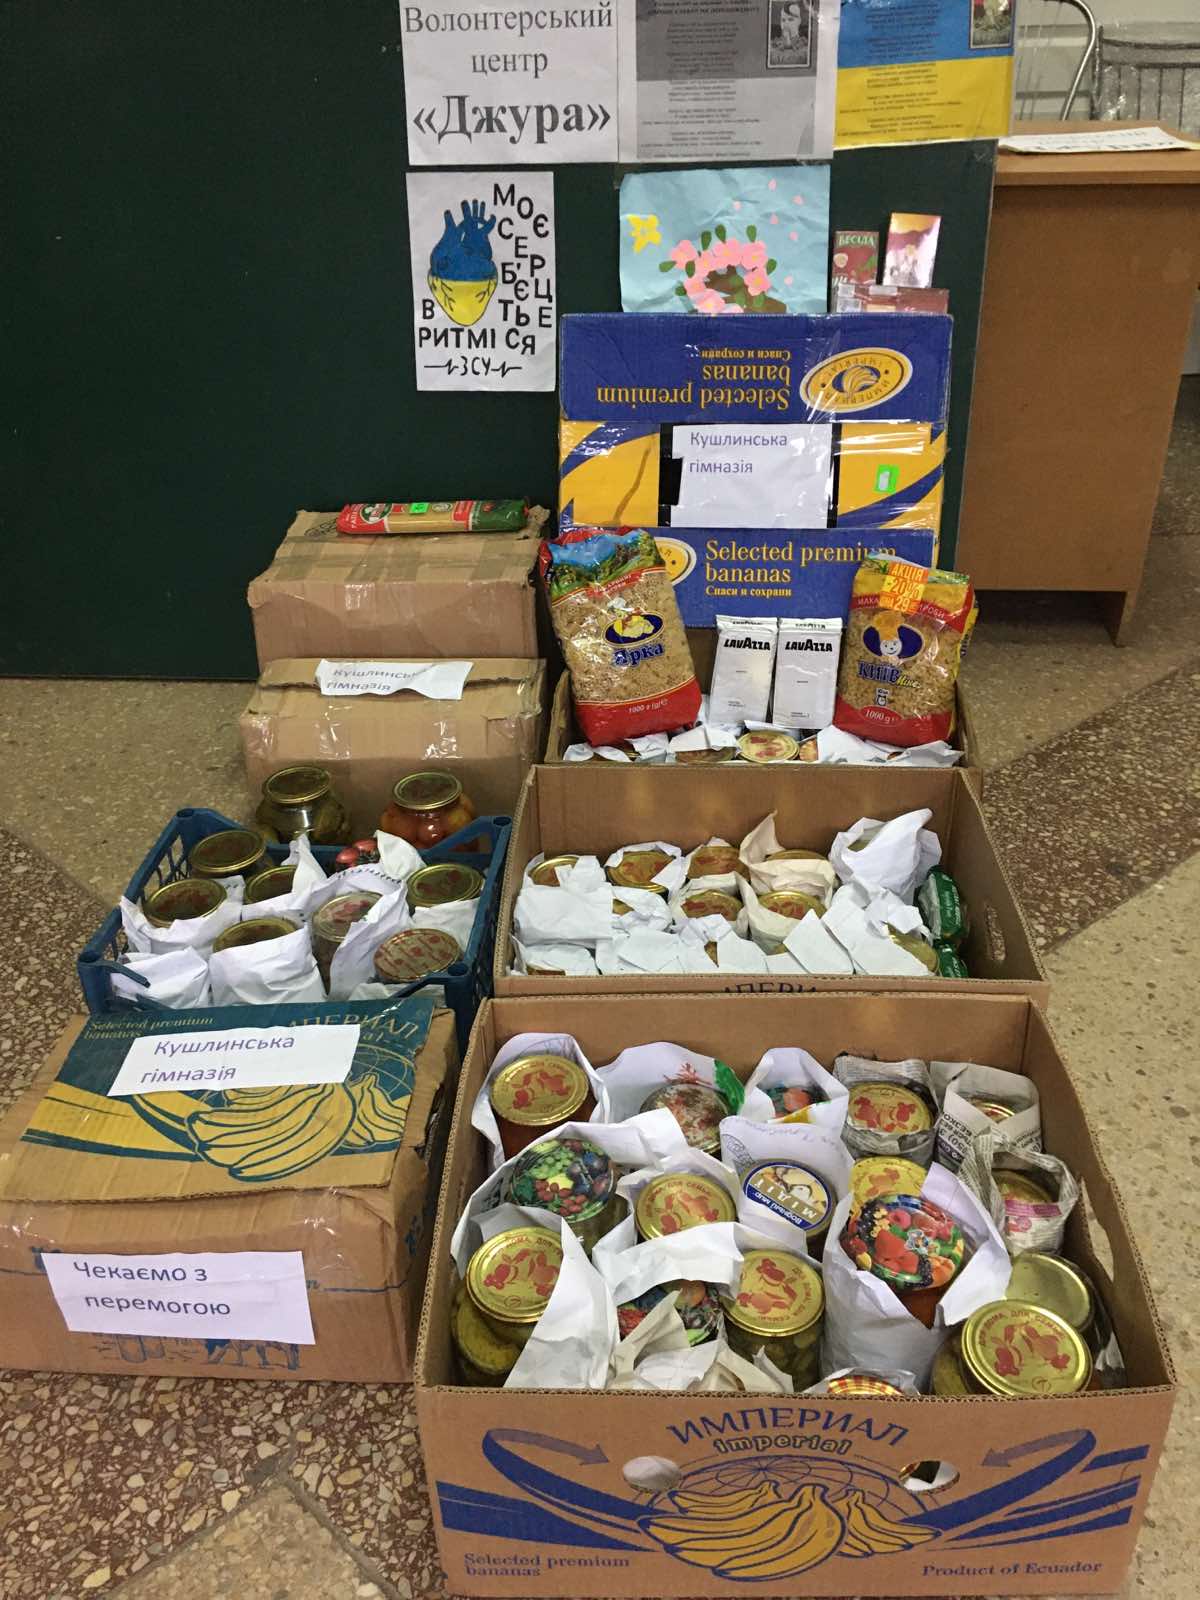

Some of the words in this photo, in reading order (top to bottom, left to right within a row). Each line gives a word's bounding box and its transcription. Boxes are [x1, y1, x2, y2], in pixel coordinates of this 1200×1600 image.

[405, 1, 613, 37] Волонтерський
[472, 53, 548, 78] центр
[413, 95, 611, 144] «Джура»
[422, 299, 435, 320] В
[418, 327, 496, 349] РИТМІ
[758, 349, 791, 361] Спаси
[703, 364, 791, 386] bananas
[597, 382, 694, 409] premium
[701, 388, 790, 410] Selected
[690, 431, 788, 448] Кушлинська
[689, 459, 753, 473] гімназія
[705, 540, 794, 561] Selected
[705, 563, 792, 583] bananas
[891, 563, 924, 582] АКЦІЯ
[705, 586, 738, 597] Спаси
[741, 588, 747, 596] и
[750, 588, 792, 599] сохрани
[724, 637, 770, 650] LAVAZZA
[785, 638, 833, 652] LAVAZZA
[865, 709, 885, 720] 1000
[92, 1018, 148, 1030] Selected
[151, 1016, 214, 1030] premium
[154, 1038, 295, 1058] Кушлинська
[140, 1065, 236, 1083] гімназія
[74, 1261, 187, 1281] Чекаємо
[194, 1268, 208, 1282] з
[85, 1295, 231, 1315] перемогою
[666, 1407, 910, 1446] ИМПЕРИАЛ
[713, 1434, 853, 1454] imperial
[463, 1552, 541, 1566] Selected
[547, 1555, 630, 1568] premium
[922, 1564, 995, 1577] Product
[1000, 1562, 1020, 1575] of
[1025, 1560, 1103, 1574] Ecuador
[466, 1565, 541, 1577] bananas
